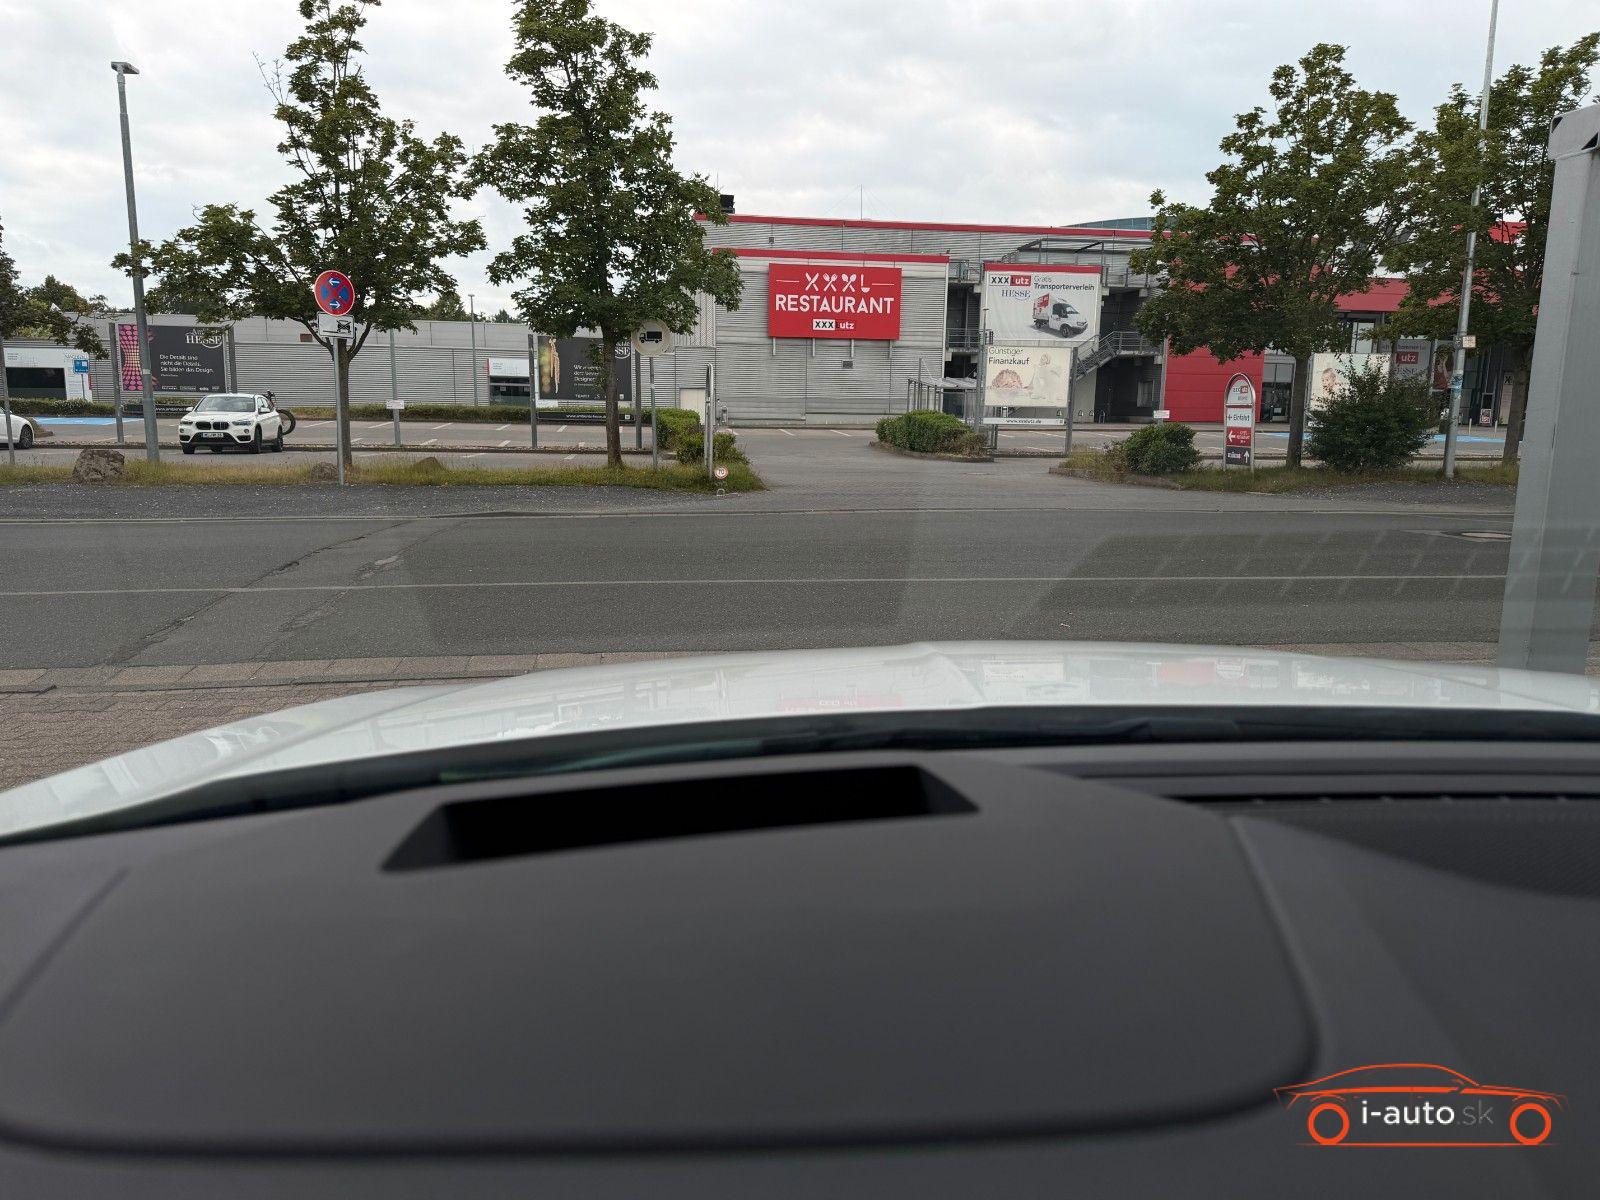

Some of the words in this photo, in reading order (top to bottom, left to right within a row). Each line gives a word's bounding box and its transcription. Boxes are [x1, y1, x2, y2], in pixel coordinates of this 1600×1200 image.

[1033, 282, 1095, 291] Transporterverleih
[1001, 289, 1031, 298] HESSE
[775, 294, 895, 314] RESTAURANT
[988, 357, 1030, 365] Finanzkauf
